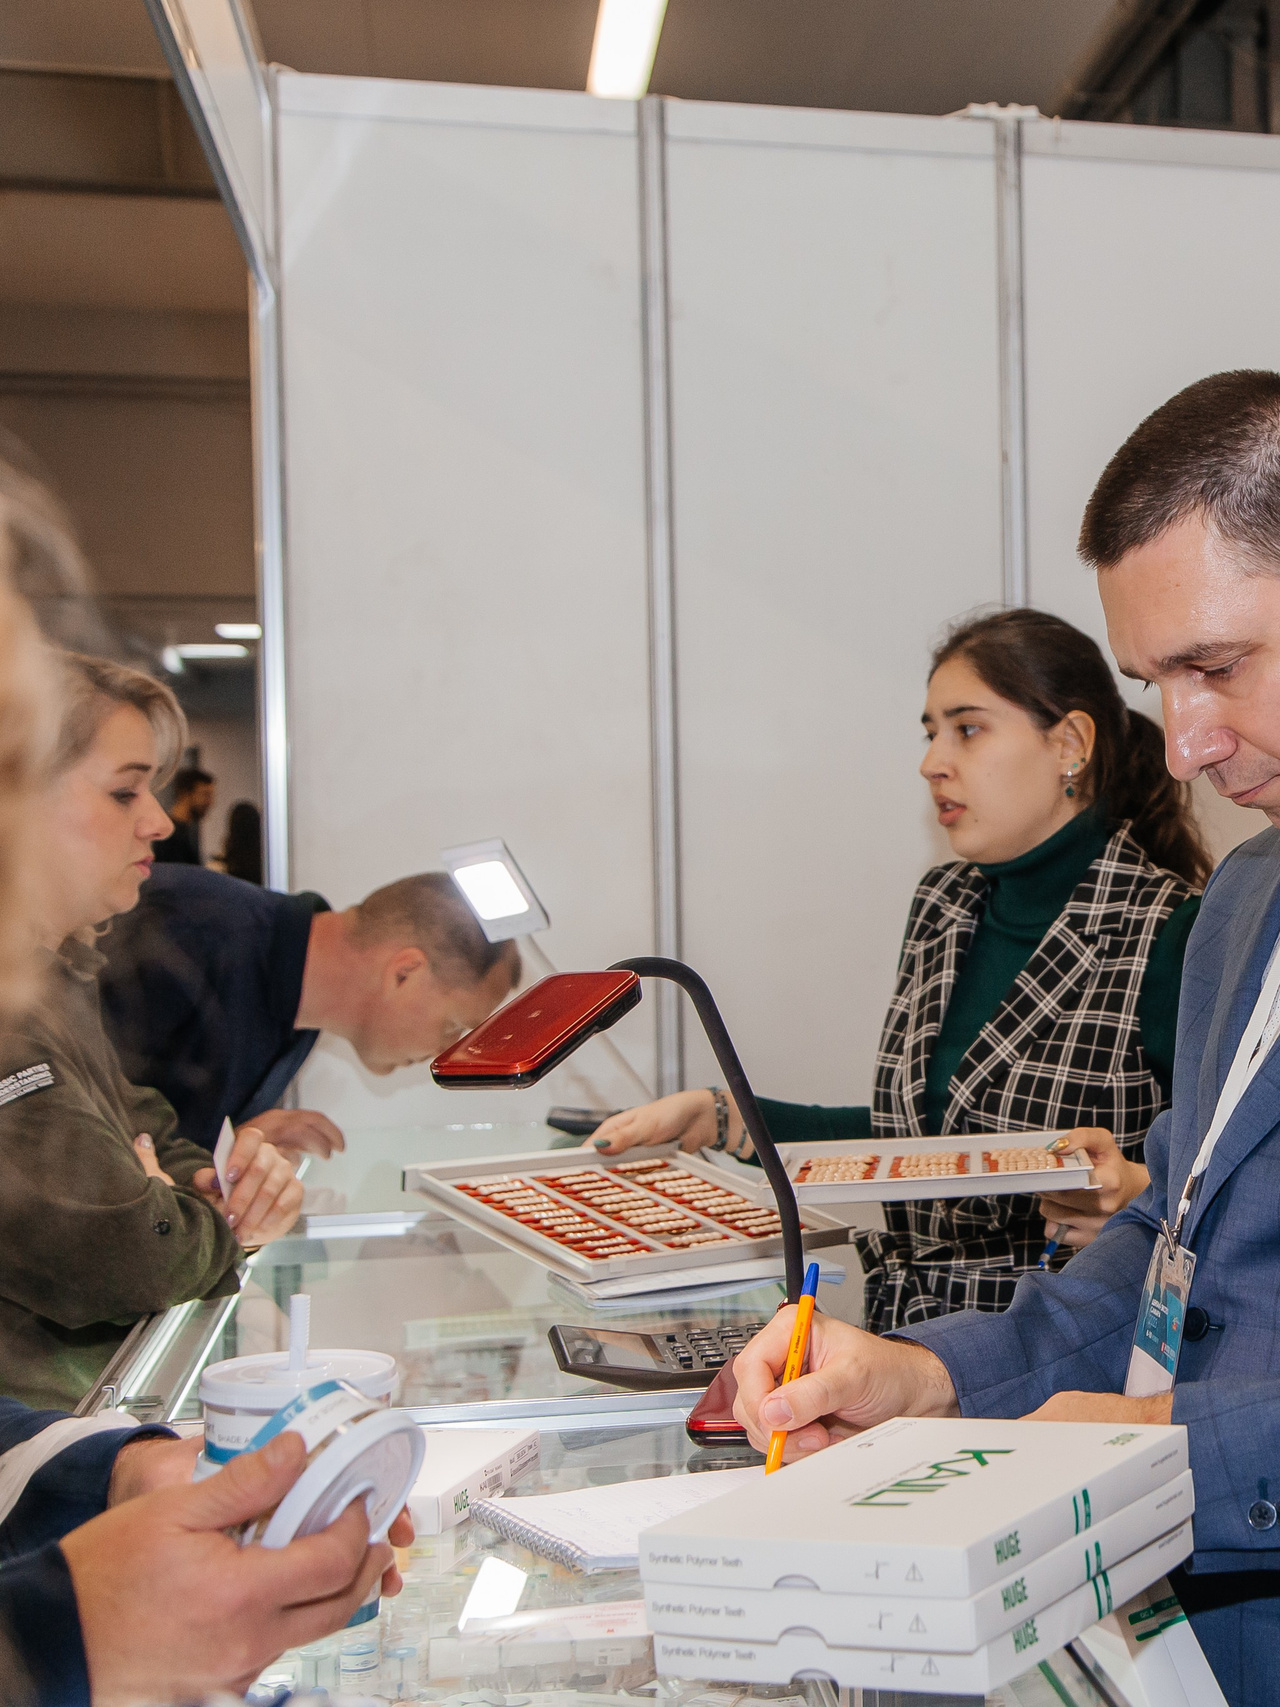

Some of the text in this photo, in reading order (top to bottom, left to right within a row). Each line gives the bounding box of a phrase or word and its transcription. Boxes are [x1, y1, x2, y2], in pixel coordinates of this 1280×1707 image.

[453, 1489, 470, 1515] HUGE
[686, 1554, 718, 1567] Polymer
[994, 1531, 1021, 1565] HUGE
[1001, 1577, 1028, 1611] HUGE
[689, 1603, 721, 1617] Polymer
[1012, 1619, 1039, 1654] HUGE
[699, 1645, 732, 1660] Polymer
